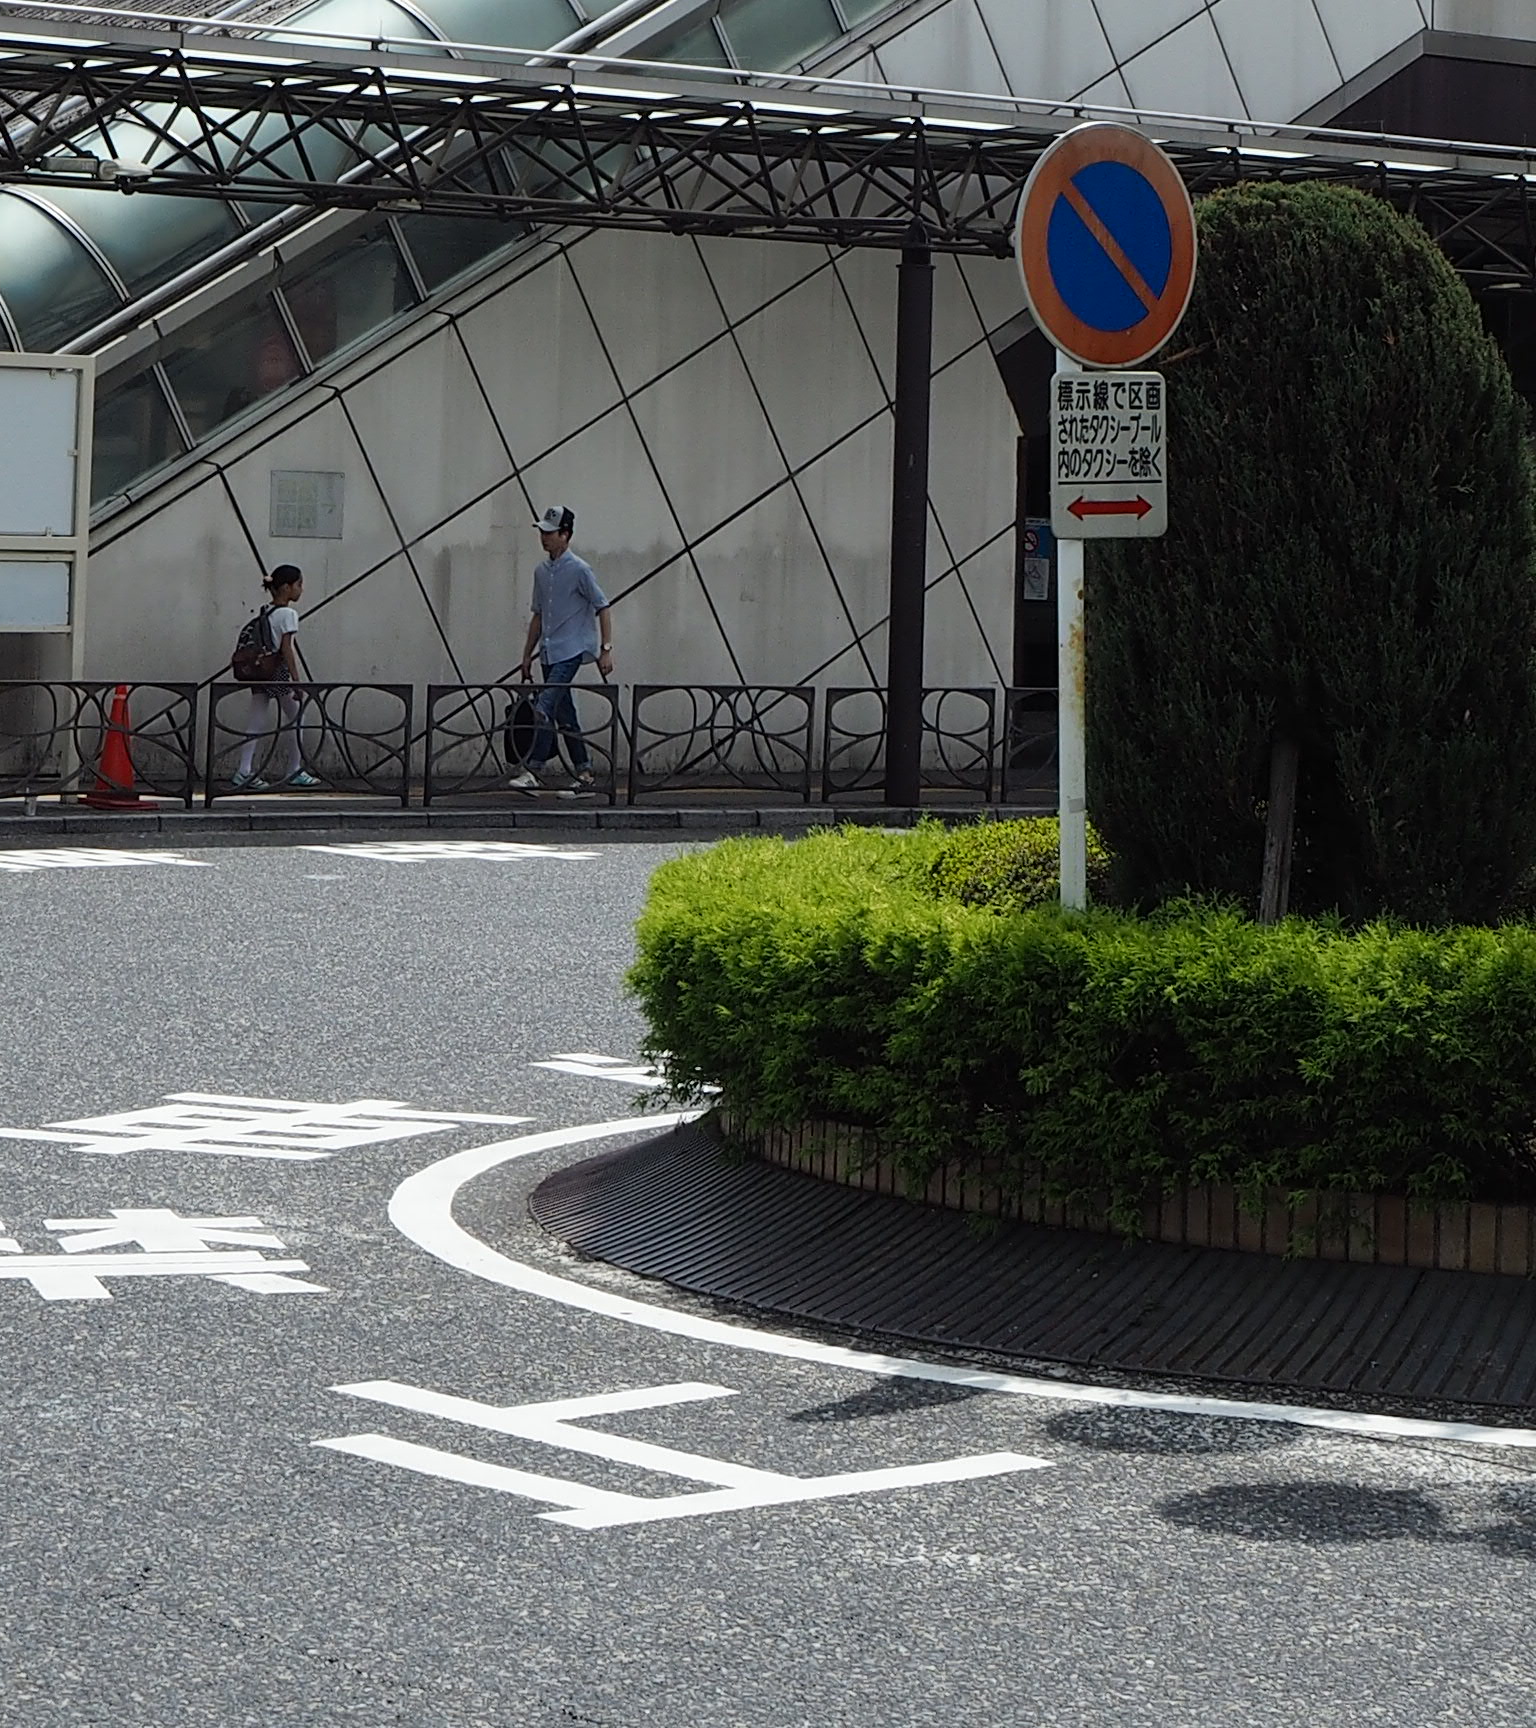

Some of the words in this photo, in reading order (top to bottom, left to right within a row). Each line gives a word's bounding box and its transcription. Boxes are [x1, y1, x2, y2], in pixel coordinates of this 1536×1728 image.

[1057, 380, 1162, 411] 標示線で区画
[1057, 413, 1163, 445] されたタクシープール
[1057, 447, 1163, 479] 内のタクシーを除く
